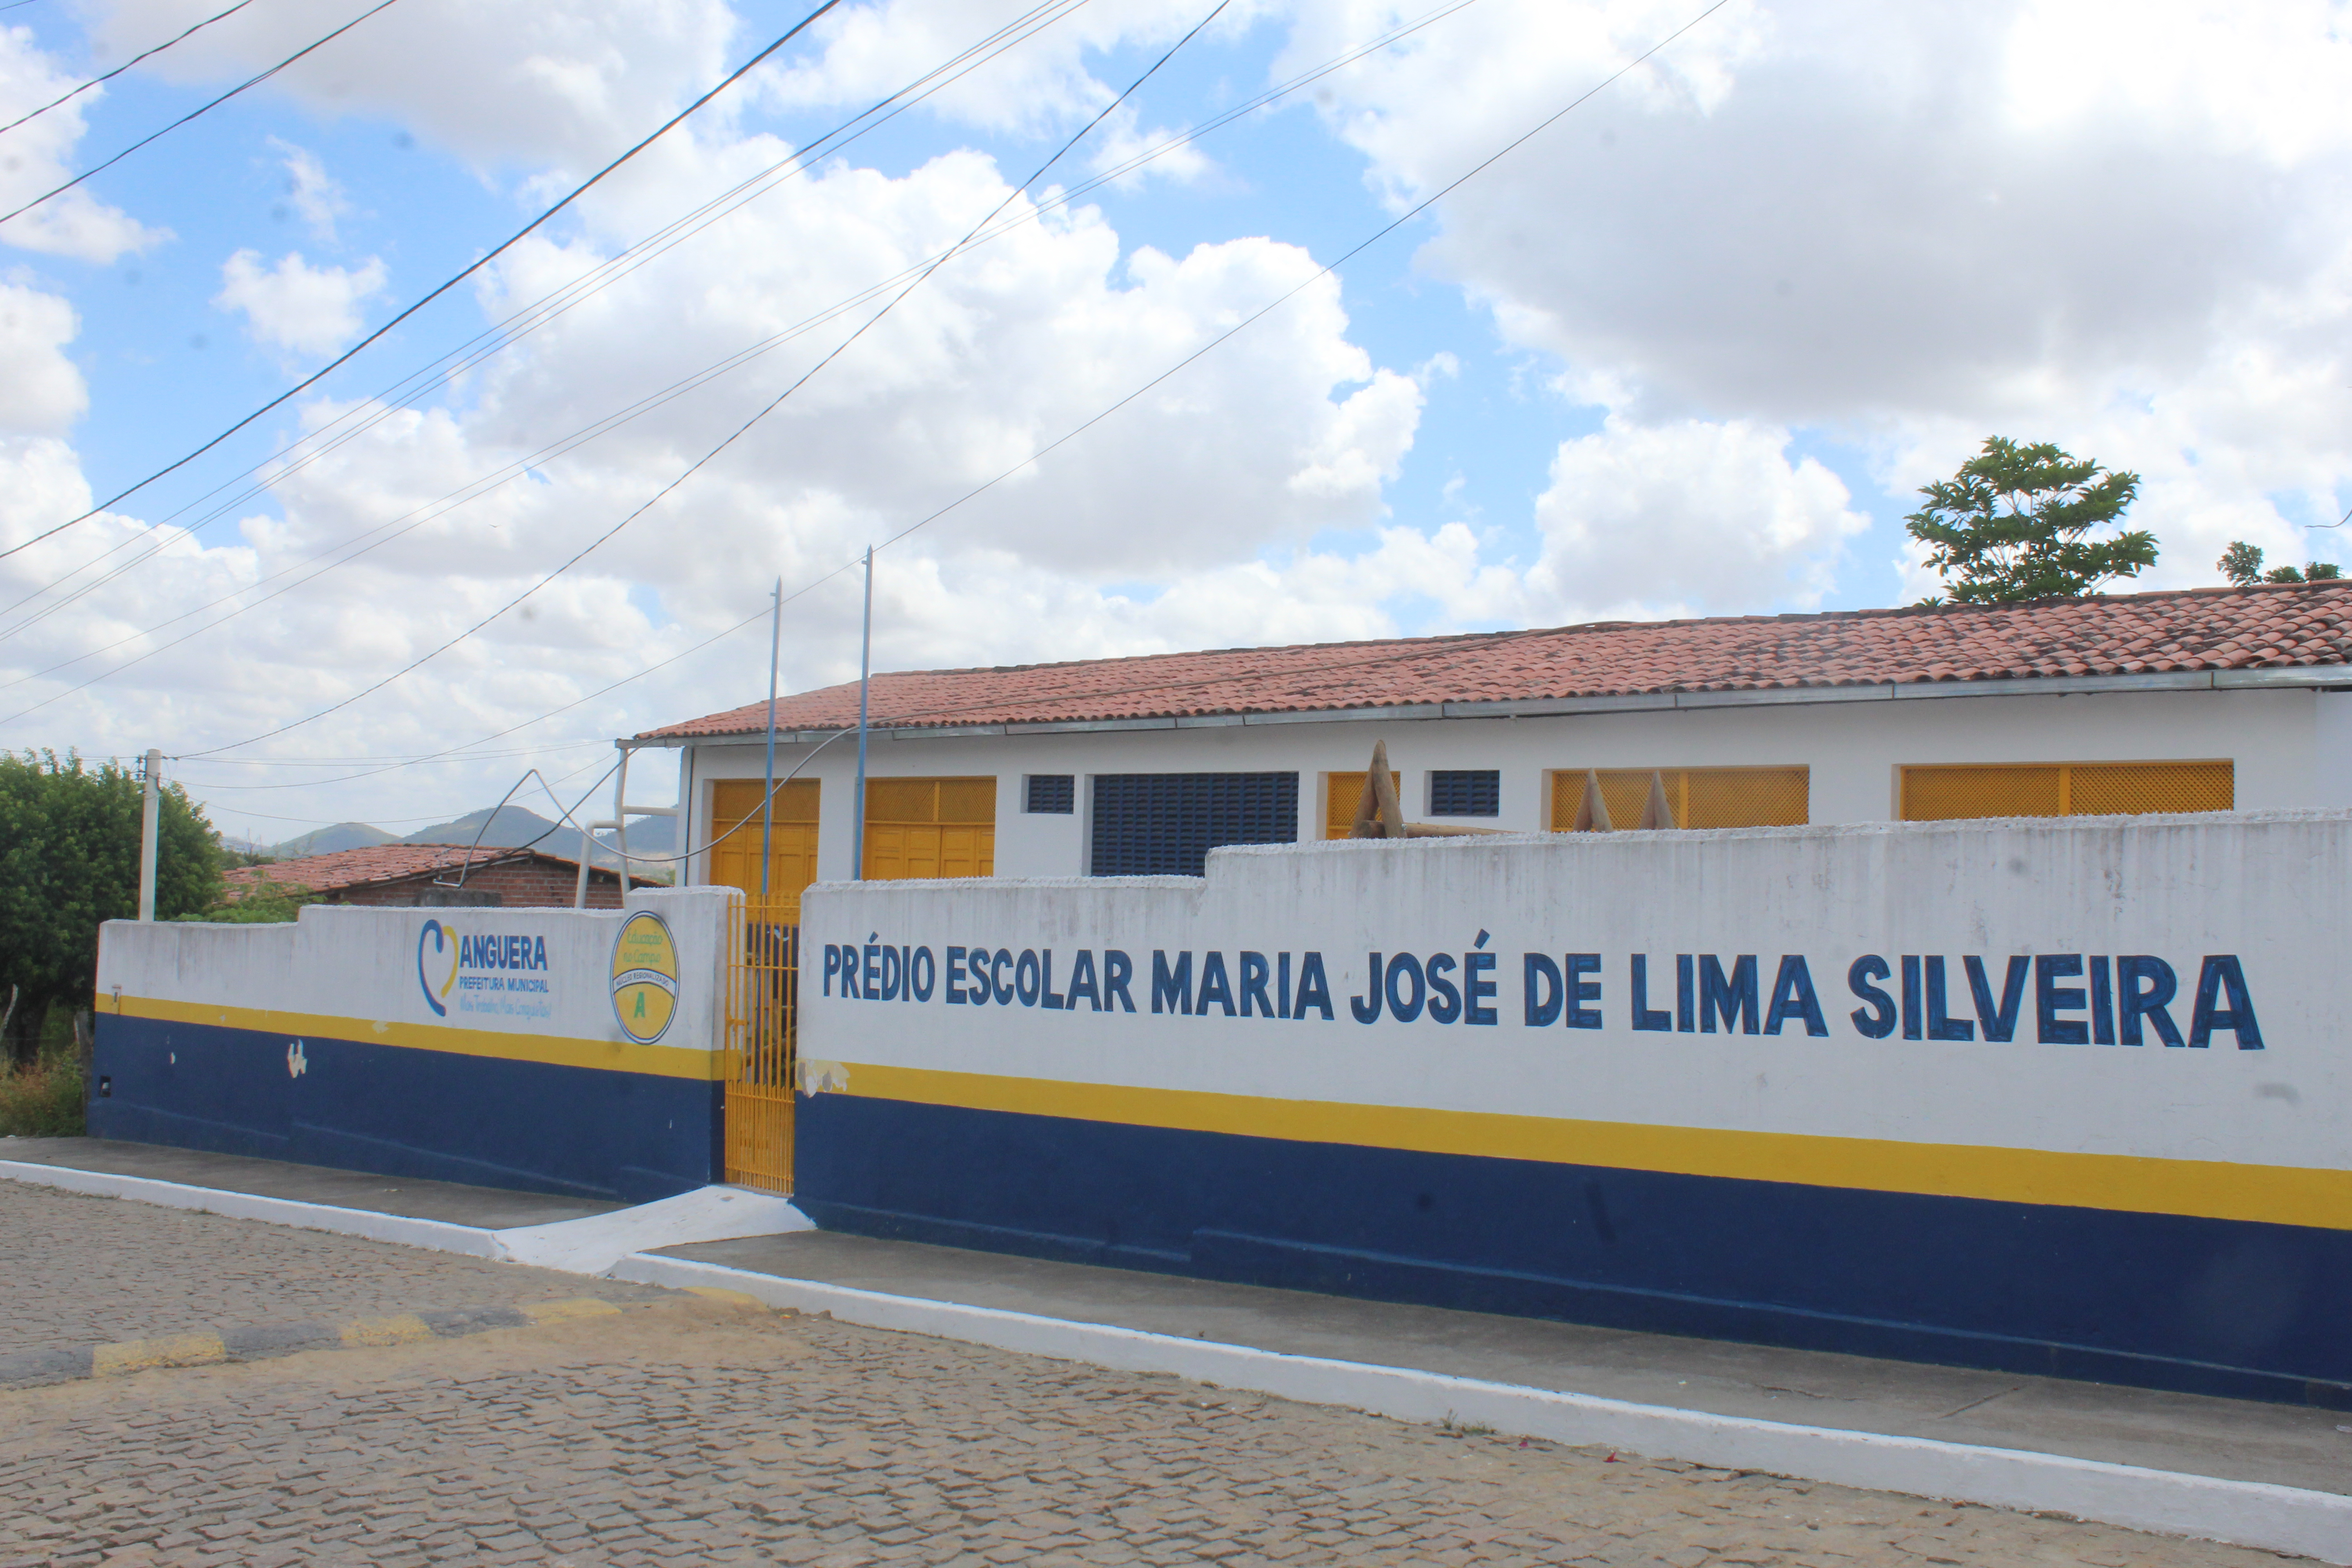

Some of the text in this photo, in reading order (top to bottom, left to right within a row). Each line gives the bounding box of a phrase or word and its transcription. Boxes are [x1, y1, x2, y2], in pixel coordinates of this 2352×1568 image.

[627, 928, 662, 945] Educação
[459, 934, 548, 970] ANGUERA
[624, 949, 661, 965] no Campo
[459, 976, 549, 993] PREFEITURA MUNICIPAL
[634, 972, 669, 986] REGIONALIZADO
[823, 928, 2266, 1051] PRÉDIO ESCOLAR MARIA JOSÉ DE LIMA SILVEIRA
[634, 991, 646, 1018] A
